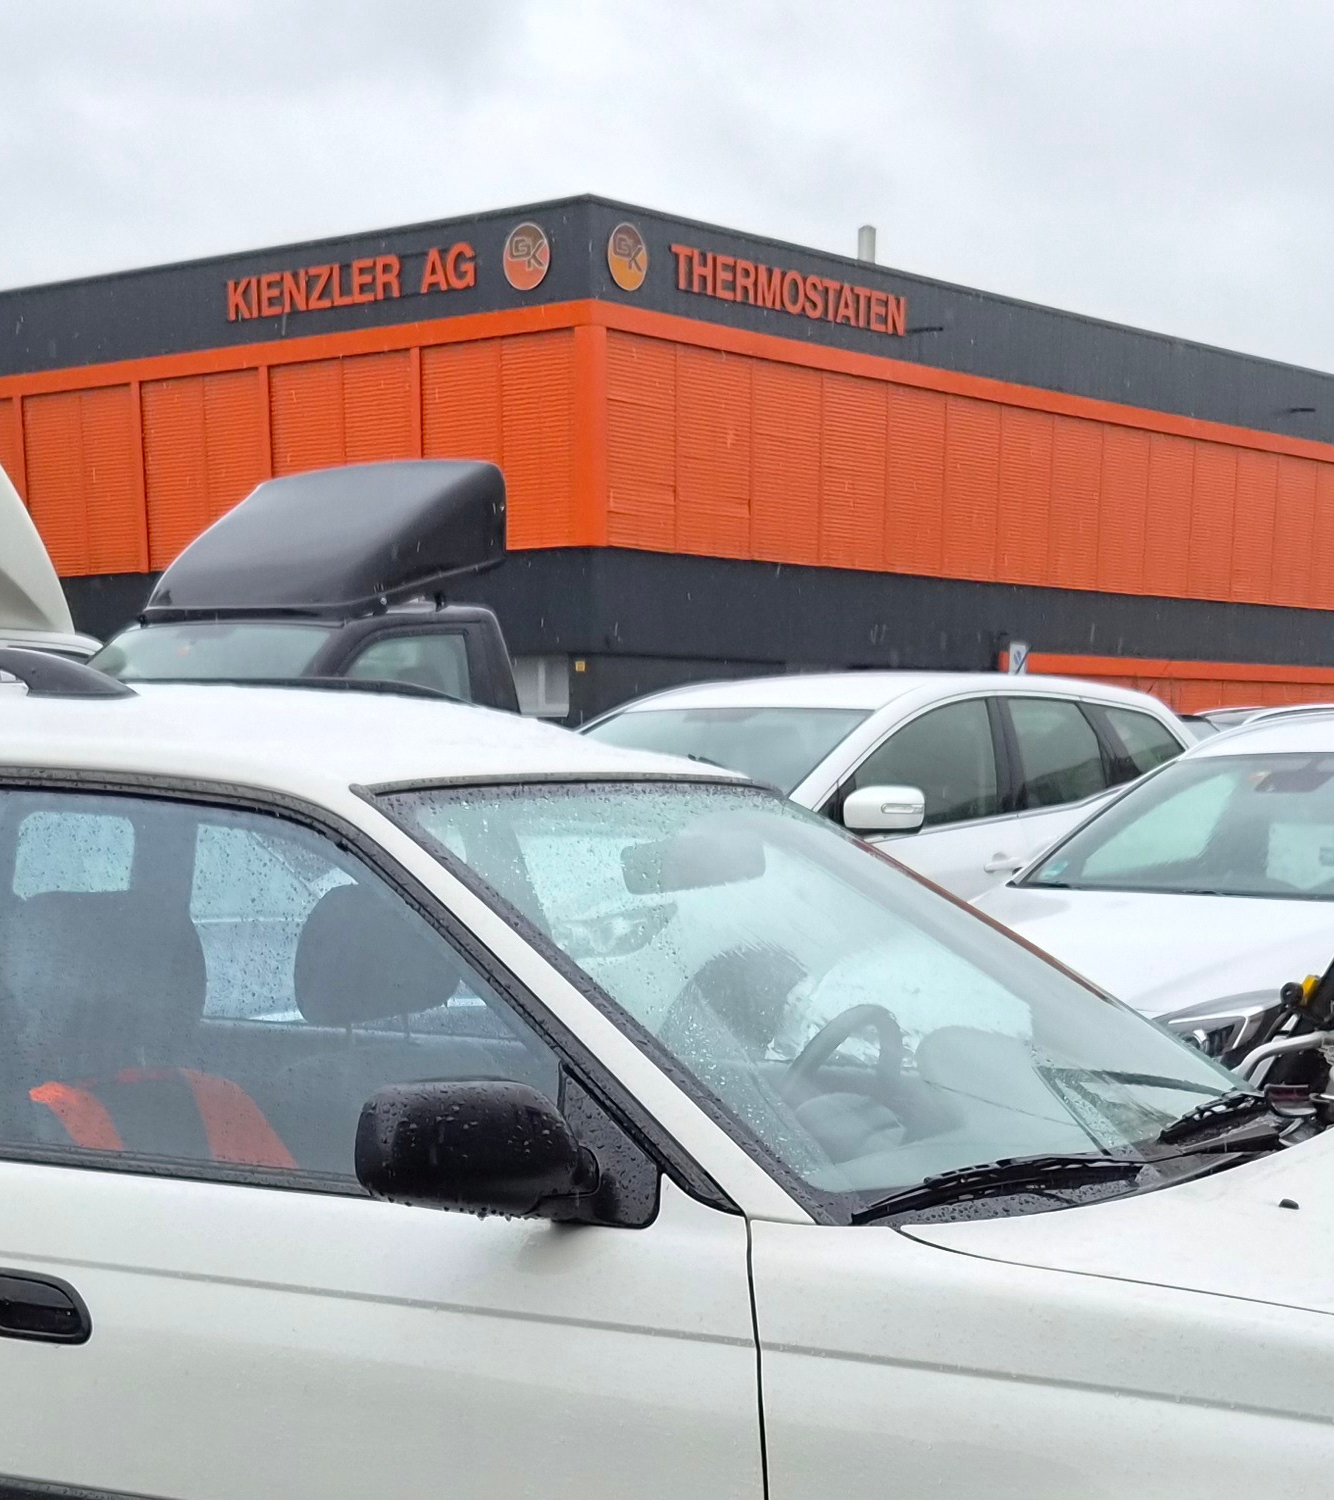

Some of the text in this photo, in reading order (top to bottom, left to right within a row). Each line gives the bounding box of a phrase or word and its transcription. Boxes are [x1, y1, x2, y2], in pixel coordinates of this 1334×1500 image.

[226, 241, 477, 322] KIENZLER AG
[670, 243, 907, 337] THERMOSTATEN
